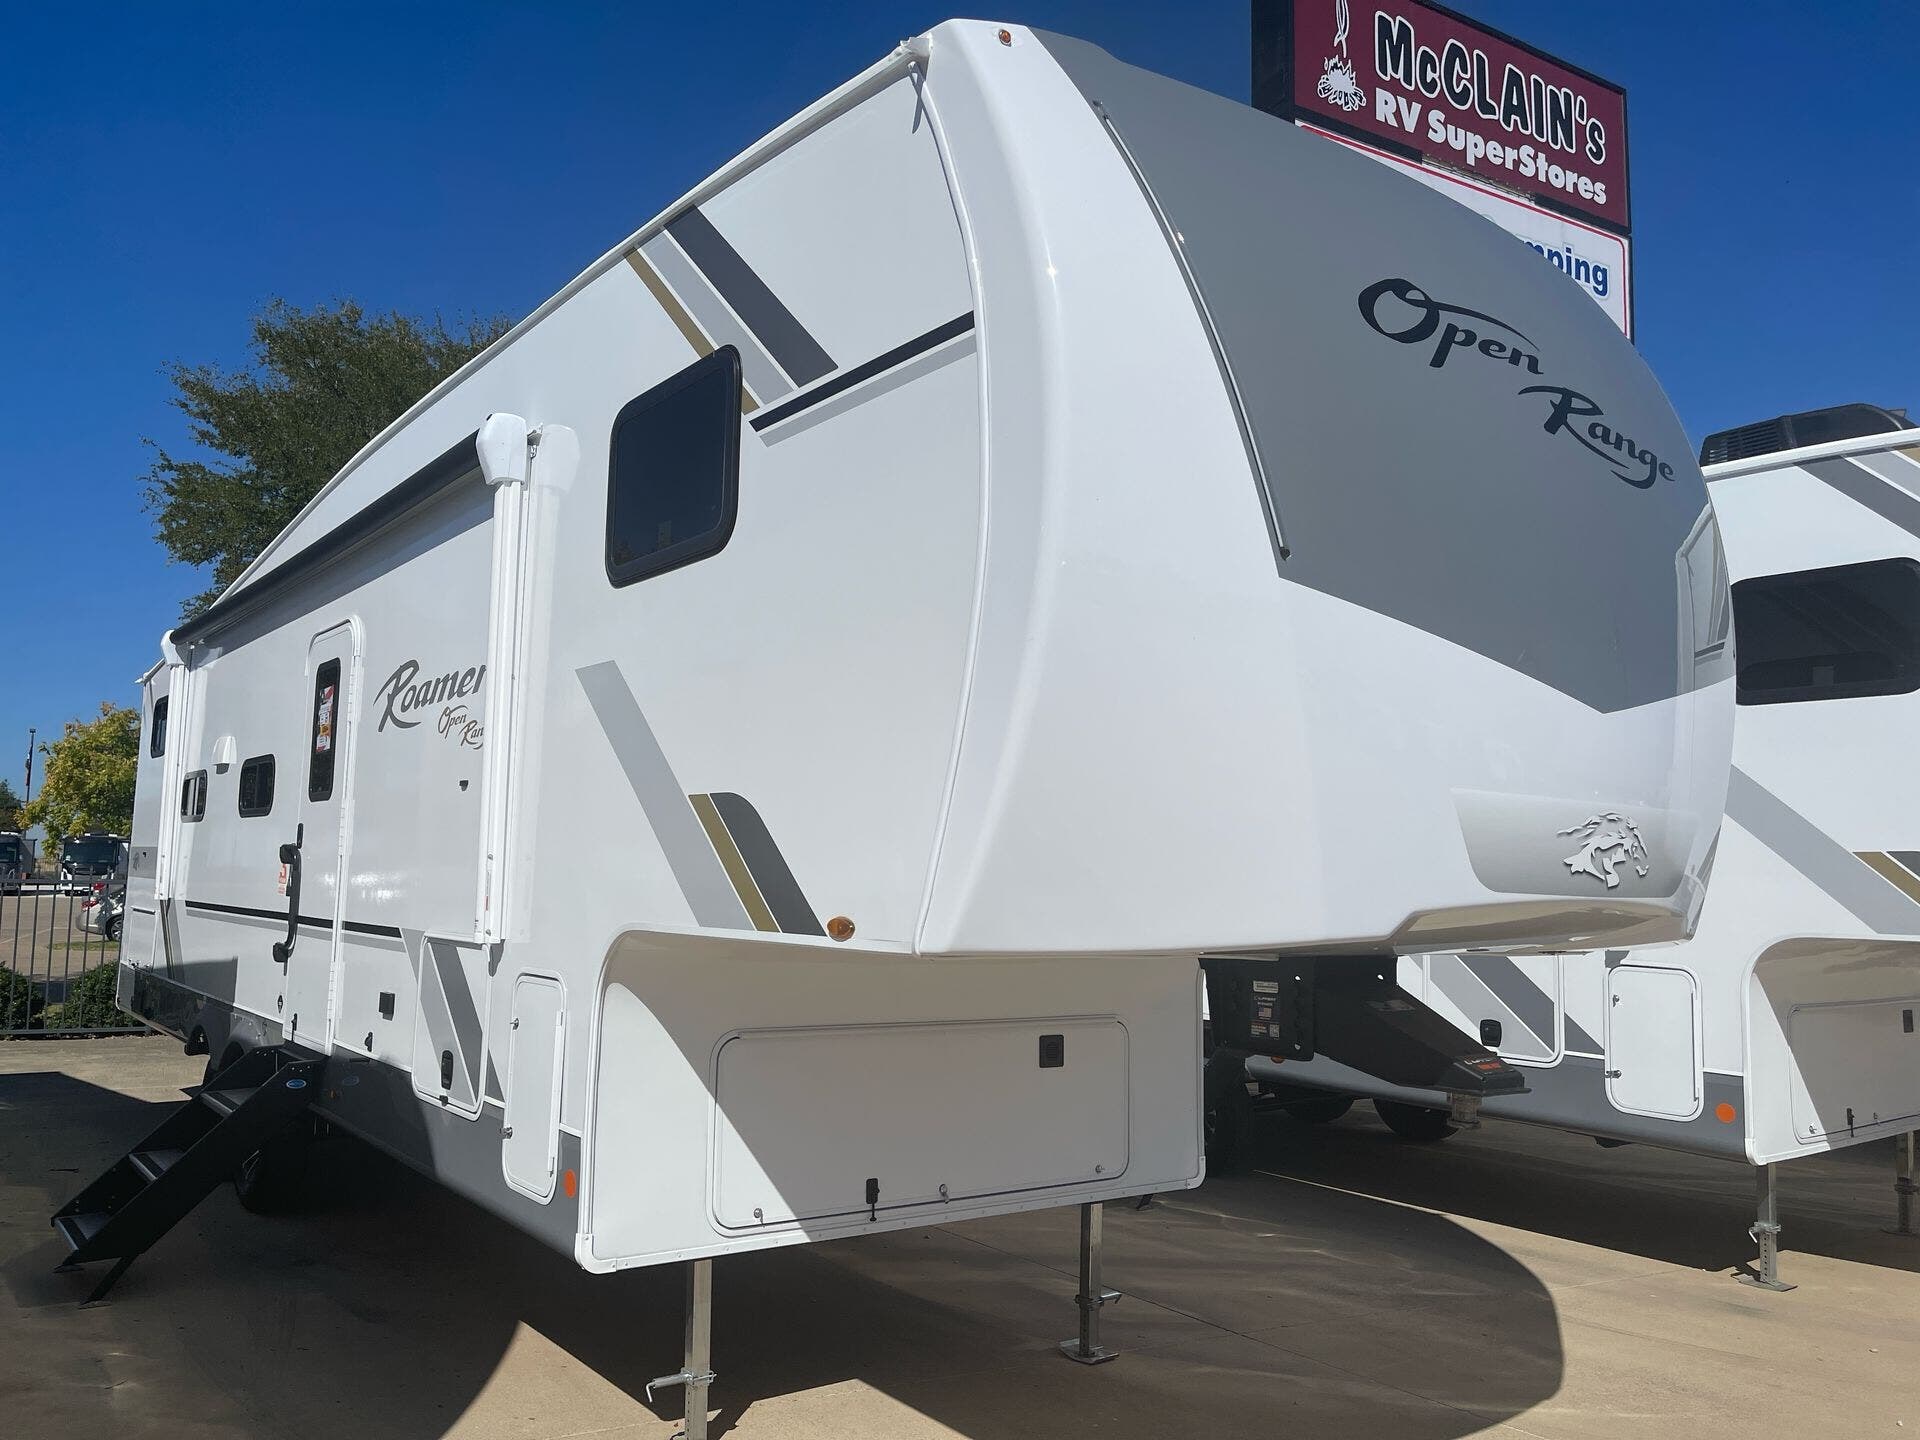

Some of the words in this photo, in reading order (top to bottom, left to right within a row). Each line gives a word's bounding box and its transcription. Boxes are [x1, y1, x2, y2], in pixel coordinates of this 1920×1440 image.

[1374, 10, 1606, 165] McCLAIN's
[1375, 87, 1422, 134] RV
[1427, 109, 1607, 205] SuperStores
[1357, 277, 1545, 375] Open
[1517, 384, 1676, 490] Range
[372, 658, 487, 733] Roamer
[437, 704, 469, 740] Open
[458, 719, 485, 750] Ran
